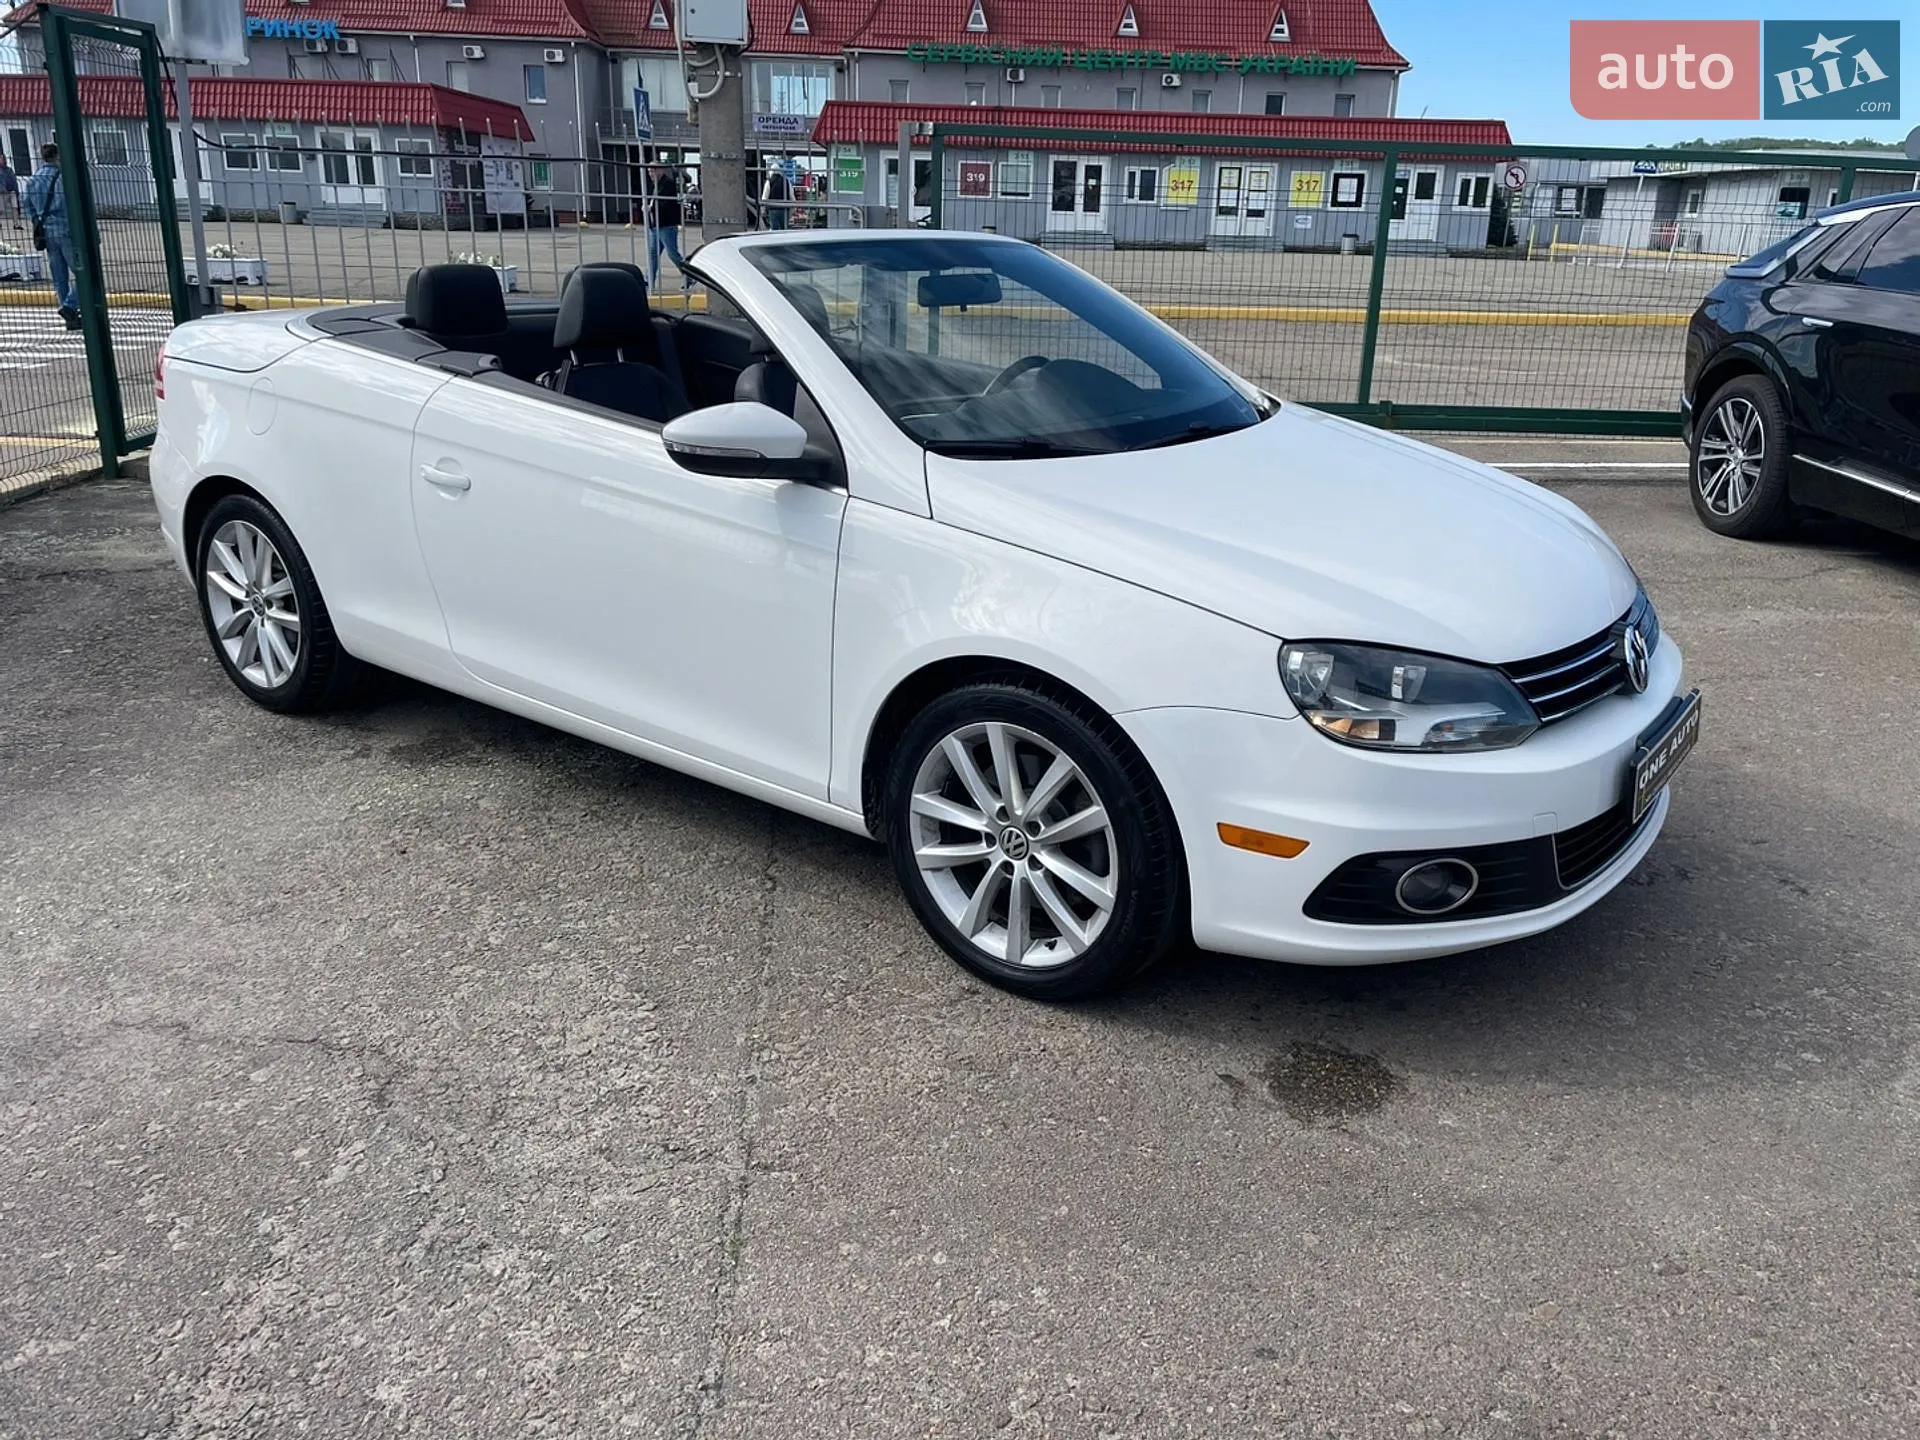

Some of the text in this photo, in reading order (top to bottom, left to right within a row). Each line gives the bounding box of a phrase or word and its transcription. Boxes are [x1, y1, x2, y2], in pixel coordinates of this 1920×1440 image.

[246, 16, 340, 40] РИНОК
[1074, 47, 1161, 72] ЦЕНТР
[1169, 52, 1229, 73] МВС
[1238, 51, 1357, 77] УКРАЇНИ
[758, 115, 799, 125] ОРЕНДА
[965, 172, 986, 182] 319
[1170, 179, 1194, 192] 317
[1295, 179, 1320, 191] 317
[1639, 748, 1668, 789] ONE
[1669, 708, 1699, 757] AUTO
